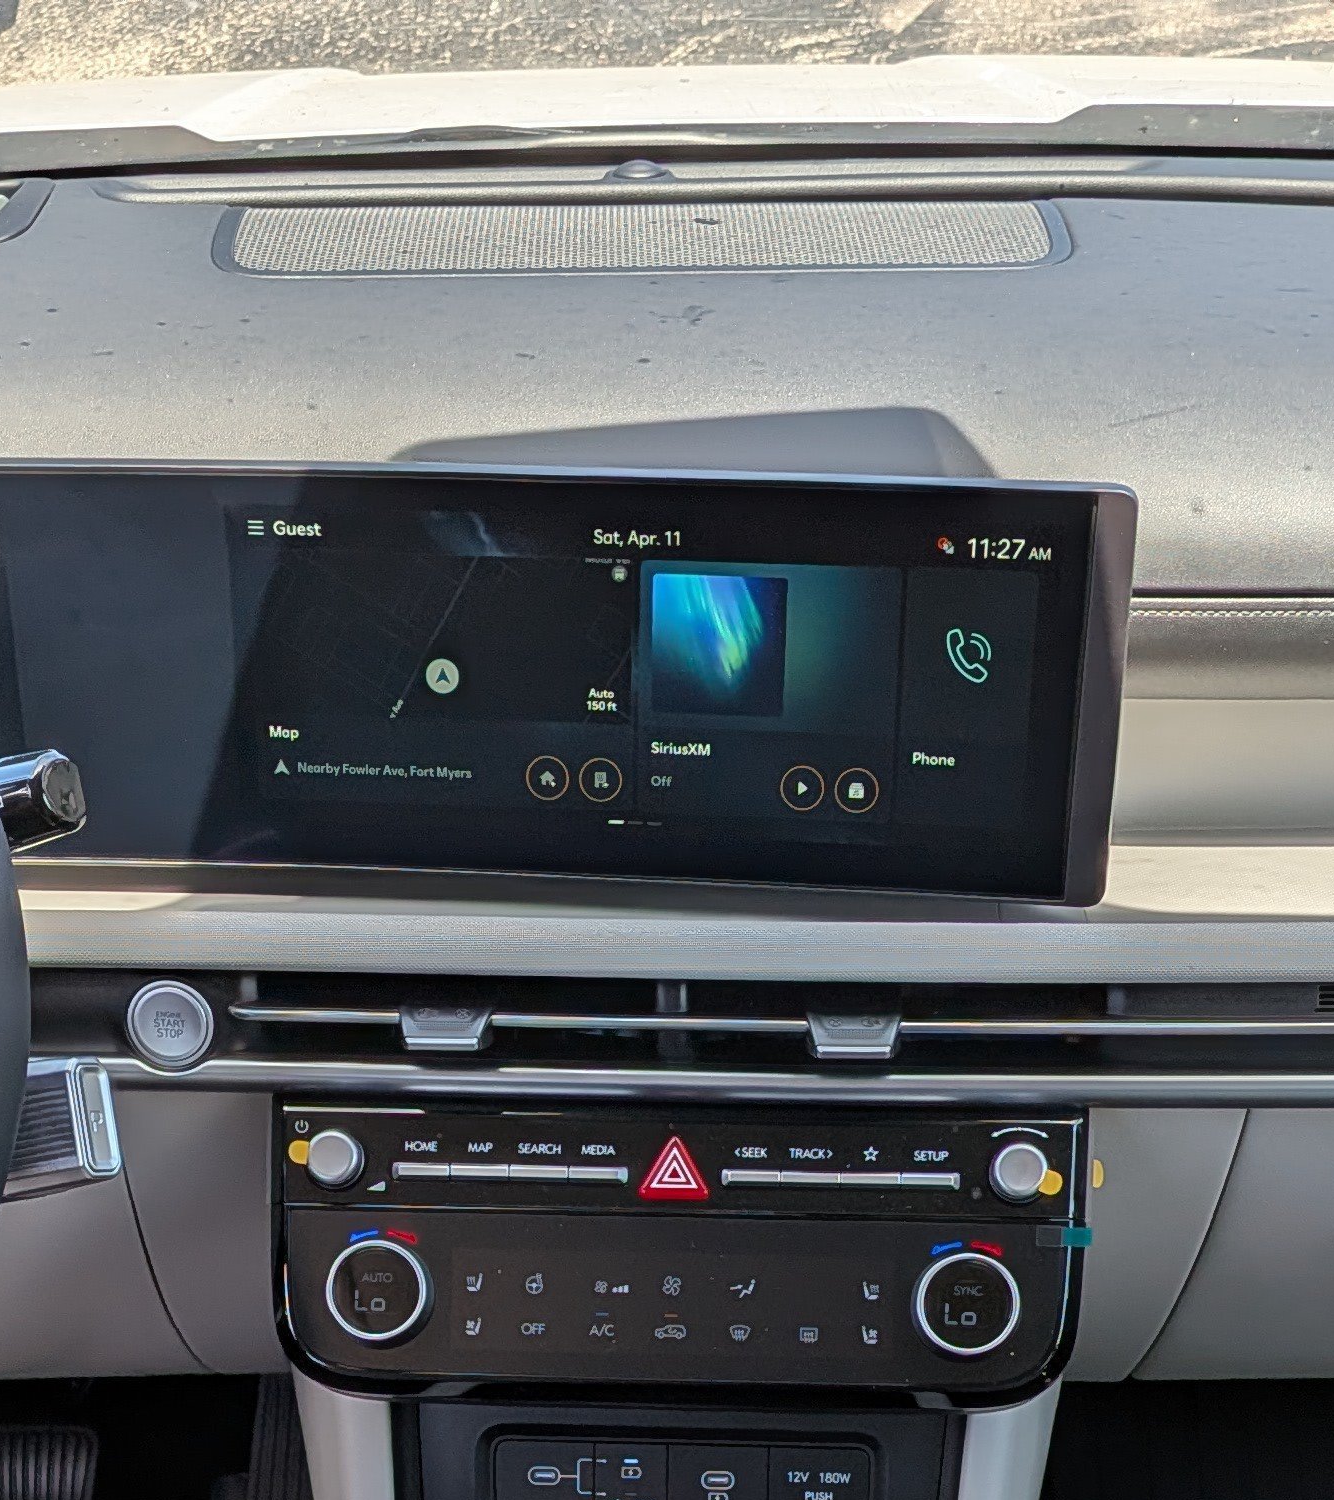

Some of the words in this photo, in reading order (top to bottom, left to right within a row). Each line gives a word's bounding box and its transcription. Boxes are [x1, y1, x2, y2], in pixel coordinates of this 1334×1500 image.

[273, 520, 322, 536] Guest
[593, 529, 623, 547] Sat,
[628, 530, 660, 549] Apr.
[665, 531, 681, 546] 11
[968, 538, 1026, 559] 11:27
[1028, 547, 1051, 561] AM
[588, 688, 614, 699] Auto
[586, 701, 605, 711] 150
[607, 701, 617, 711] ft
[269, 725, 299, 741] Map
[651, 742, 710, 756] SiriusXM
[912, 752, 955, 766] Phone
[298, 762, 340, 776] Nearby
[342, 764, 381, 775] Fowler
[383, 765, 408, 778] Ave,
[410, 765, 434, 777] Fort
[437, 767, 472, 780] Myers
[651, 775, 672, 787] Off
[153, 1018, 186, 1028] START
[156, 1027, 184, 1039] STOP
[404, 1140, 438, 1152] HOME
[468, 1142, 493, 1152] MAP
[518, 1143, 562, 1154] SEARCH
[581, 1144, 616, 1156] MEDIA
[914, 1149, 949, 1161] SETUP
[361, 1272, 393, 1283] AUTO
[953, 1285, 984, 1297] SYNC
[354, 1290, 386, 1312] Lo
[945, 1303, 976, 1325] Lo
[521, 1323, 545, 1335] OFF
[589, 1323, 615, 1337] A/C
[787, 1471, 810, 1484] 12V
[819, 1471, 851, 1485] 180W
